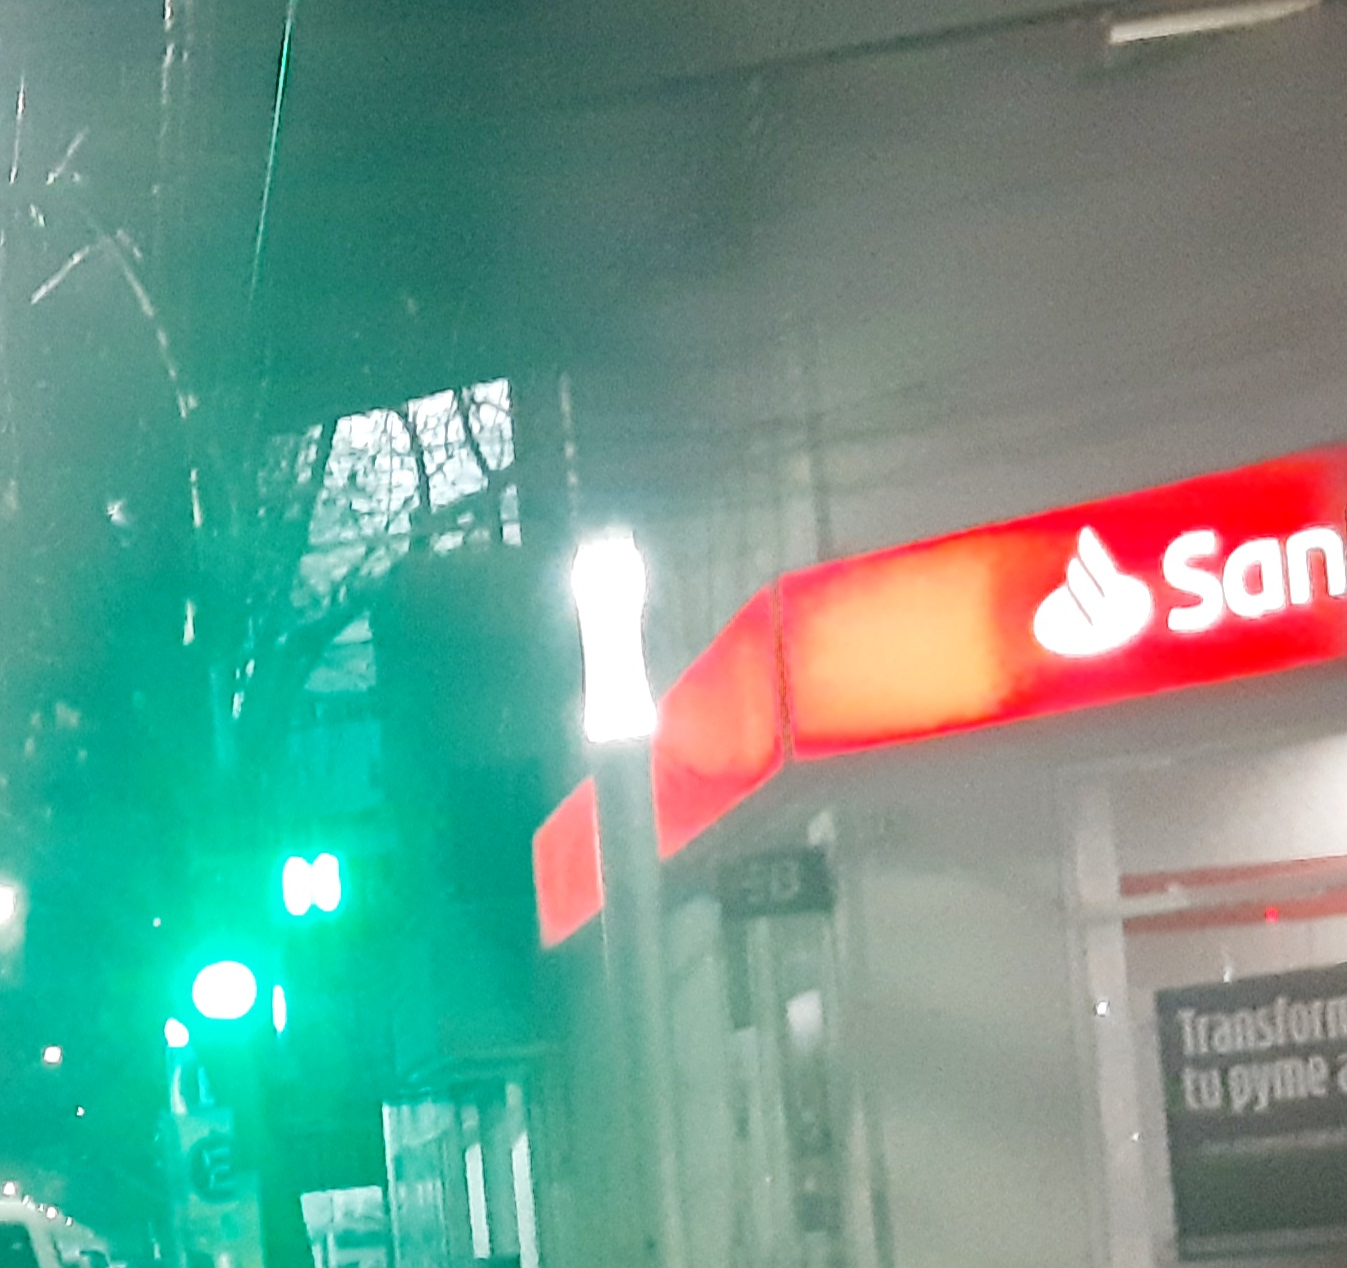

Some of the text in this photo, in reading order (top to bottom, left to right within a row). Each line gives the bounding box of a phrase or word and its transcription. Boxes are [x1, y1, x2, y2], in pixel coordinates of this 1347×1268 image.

[1162, 527, 1347, 633] San
[1183, 1066, 1223, 1110] tu
[1228, 1056, 1329, 1114] pyme
